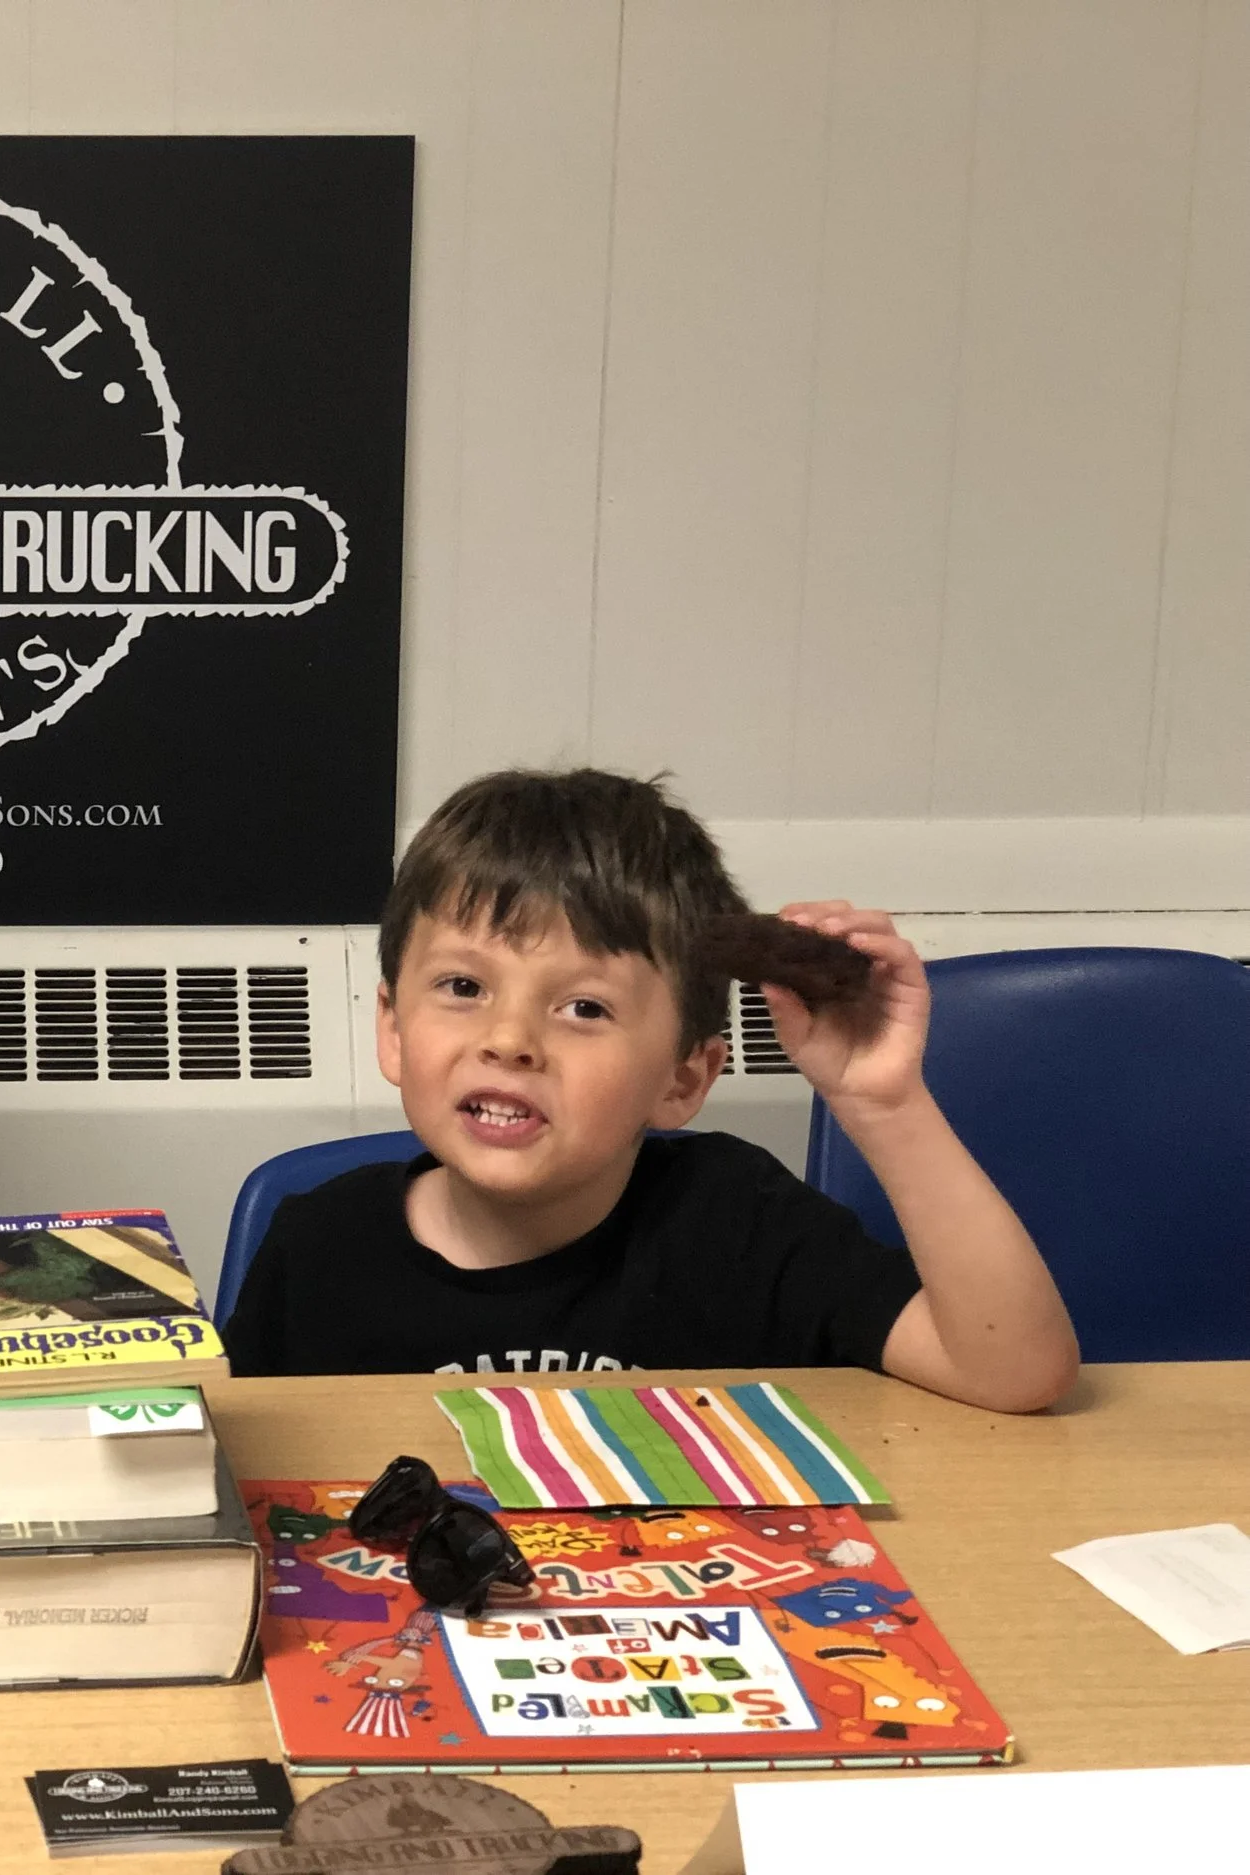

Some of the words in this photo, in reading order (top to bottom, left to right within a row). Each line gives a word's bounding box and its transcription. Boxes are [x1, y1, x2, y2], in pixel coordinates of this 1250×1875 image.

[24, 1221, 42, 1230] OF
[48, 1219, 76, 1229] OUT
[81, 1217, 114, 1227] STAY
[3, 1607, 87, 1626] MEMORIAL
[89, 1606, 149, 1625] RICKER
[610, 1637, 649, 1654] of
[177, 1769, 209, 1778] Randy
[61, 1805, 279, 1822] www.KimballAndSons.com
